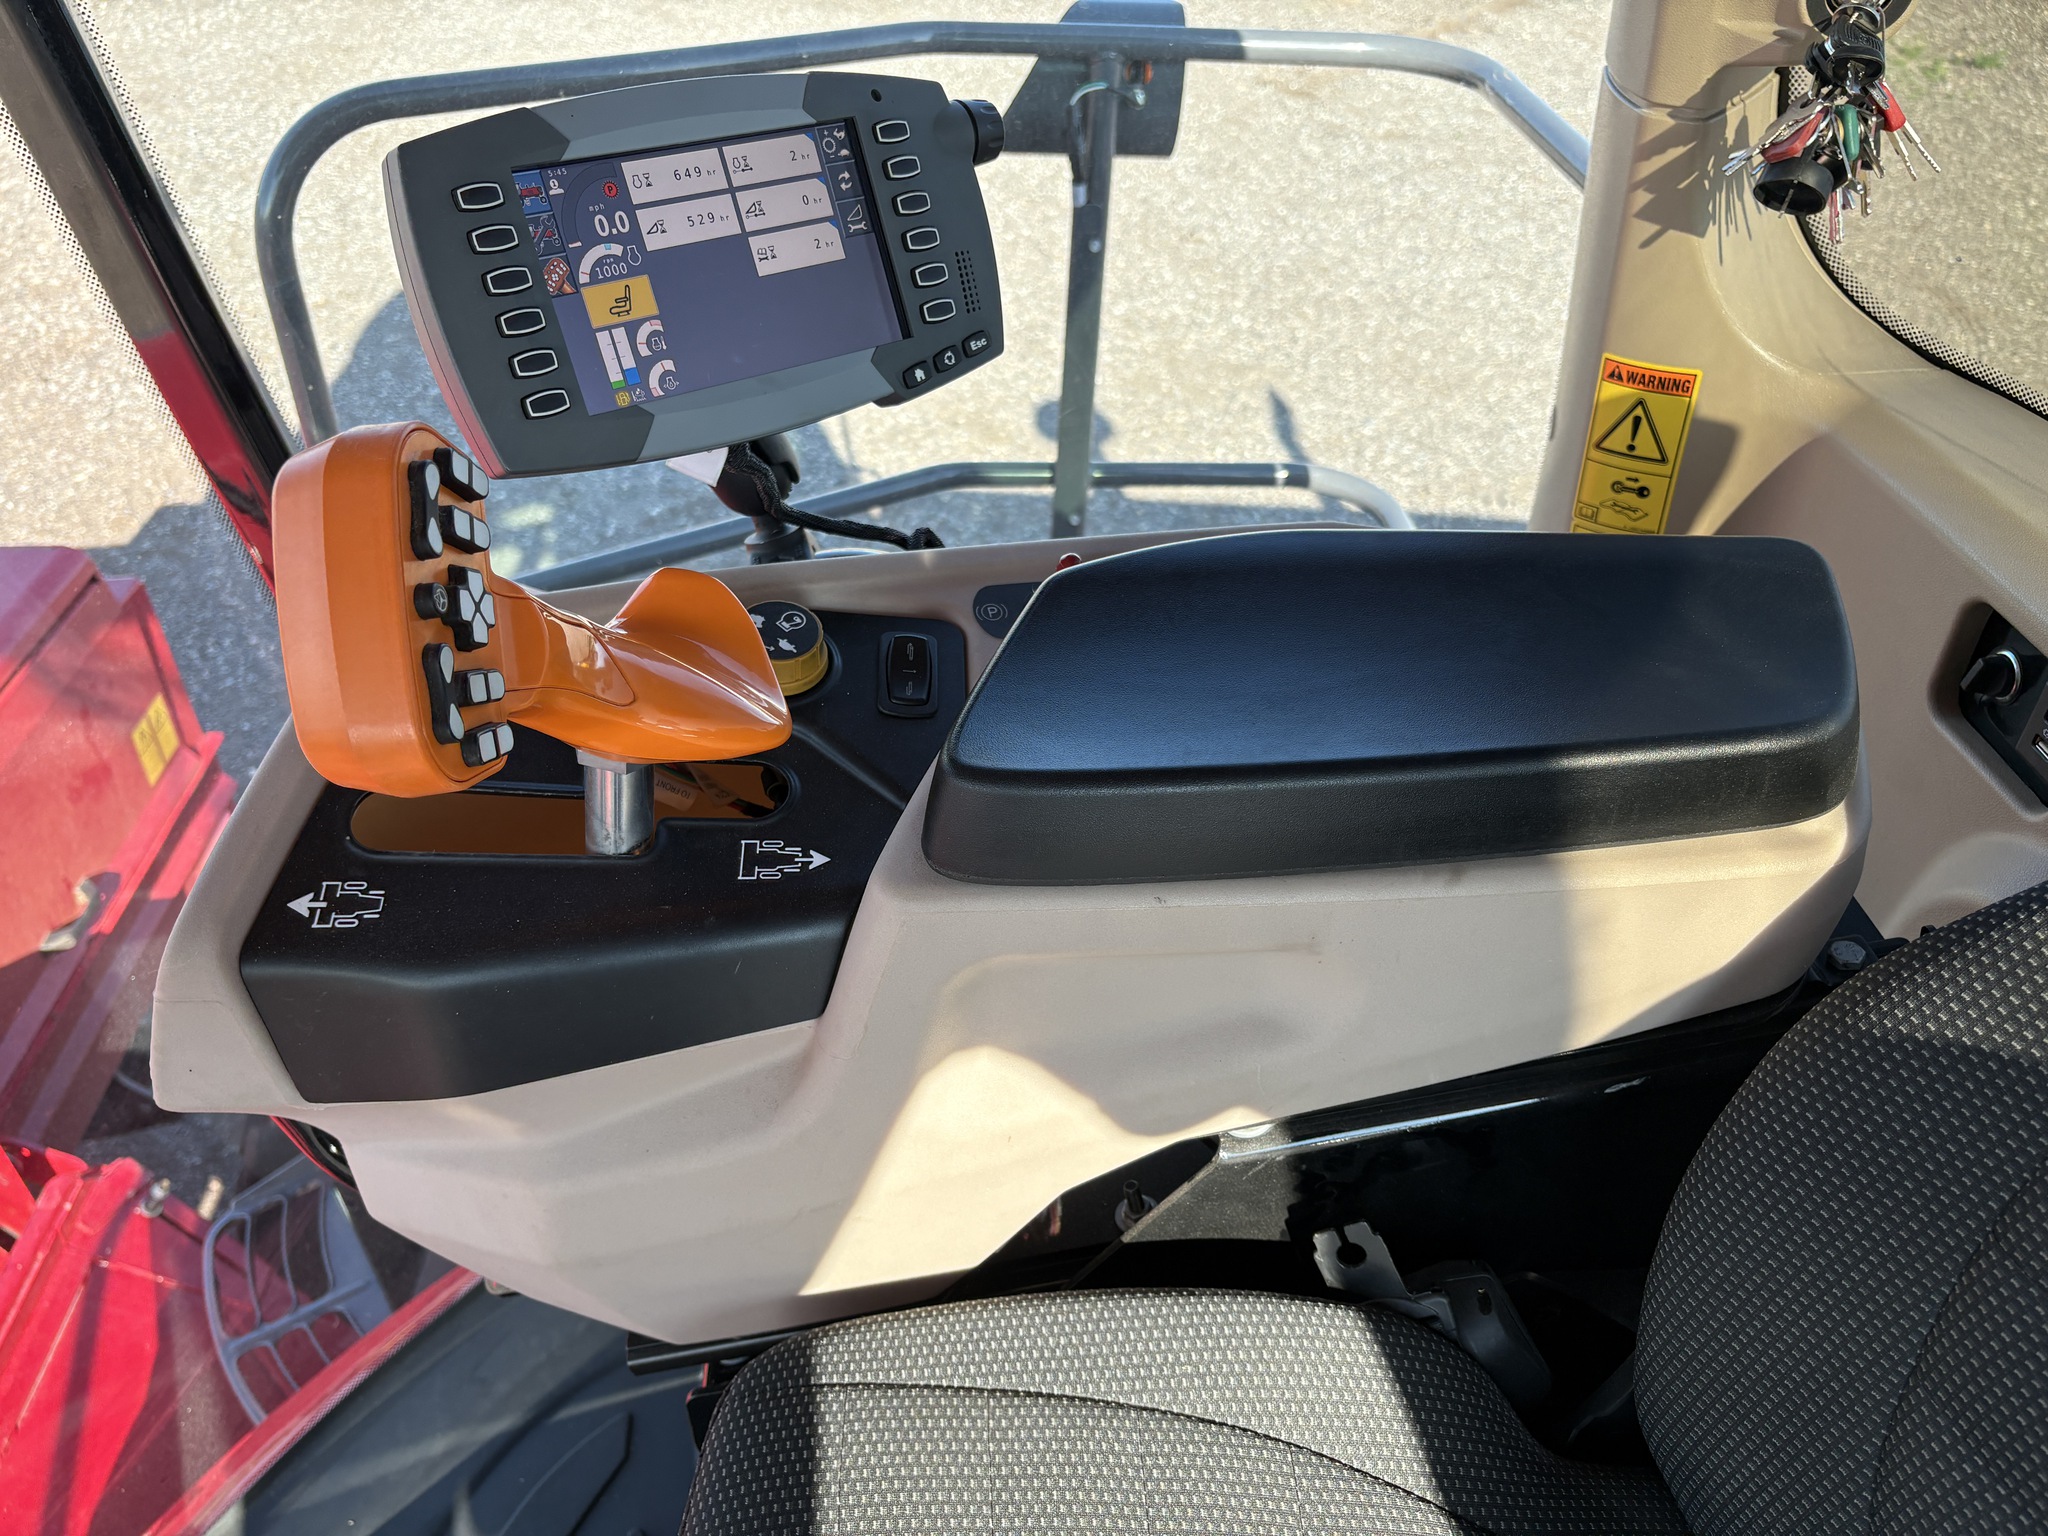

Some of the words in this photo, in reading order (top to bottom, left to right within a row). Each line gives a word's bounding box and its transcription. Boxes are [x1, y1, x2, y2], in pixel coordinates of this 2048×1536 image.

[790, 150, 798, 161] 2
[801, 153, 810, 161] hr
[547, 167, 568, 178] 5:45
[673, 166, 702, 181] 649
[706, 168, 716, 177] hr
[588, 202, 605, 212] mph
[813, 197, 822, 205] hr
[594, 210, 630, 237] 0.0
[687, 212, 715, 228] 529
[720, 214, 730, 222] hr
[813, 238, 822, 250] 2
[825, 240, 834, 248] hr
[595, 262, 628, 280] 1000
[969, 338, 988, 351] Esc
[1626, 370, 1692, 394] WARNING
[656, 779, 681, 795] FRONT
